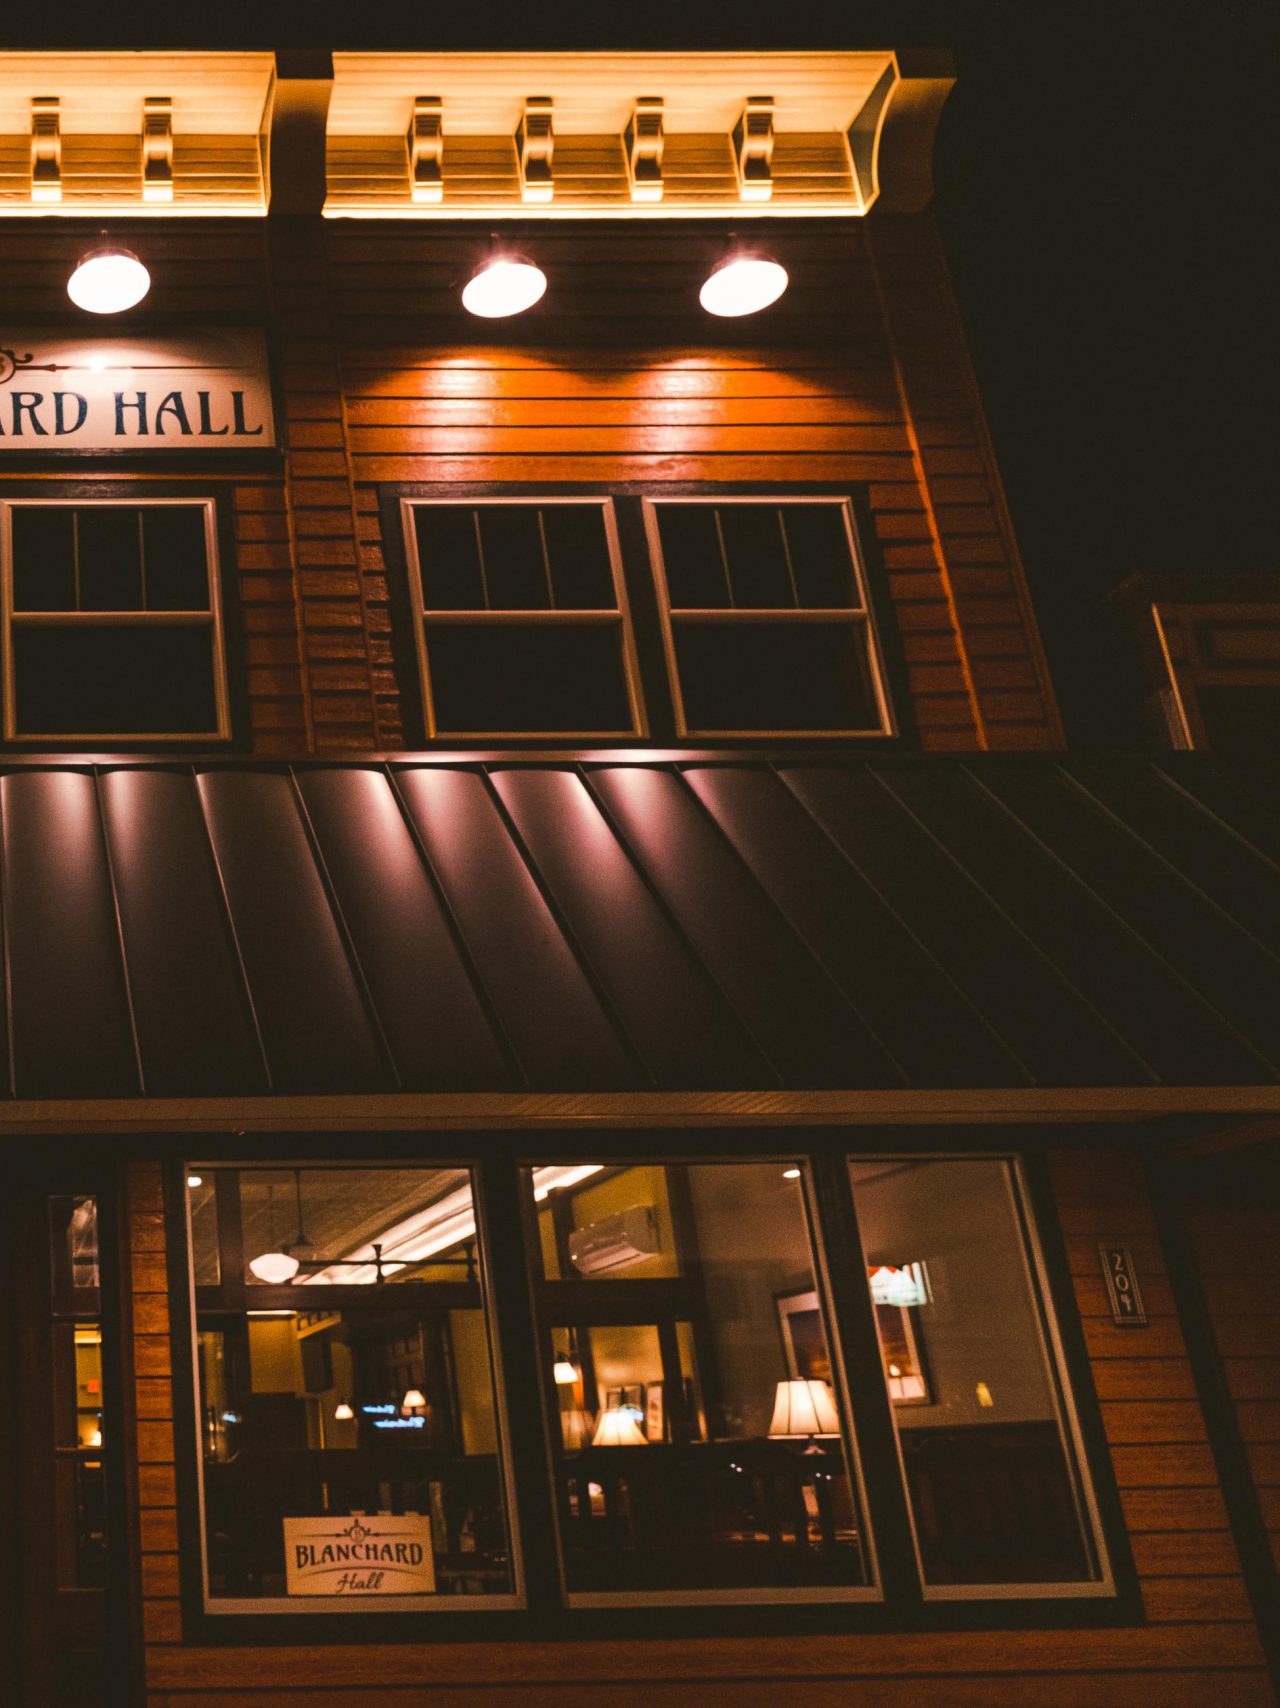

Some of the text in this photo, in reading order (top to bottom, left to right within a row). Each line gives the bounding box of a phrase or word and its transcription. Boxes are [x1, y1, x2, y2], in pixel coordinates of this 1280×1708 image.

[114, 390, 264, 436] HALL
[295, 1542, 423, 1569] BLANCHARD
[336, 1571, 385, 1593] Hall
